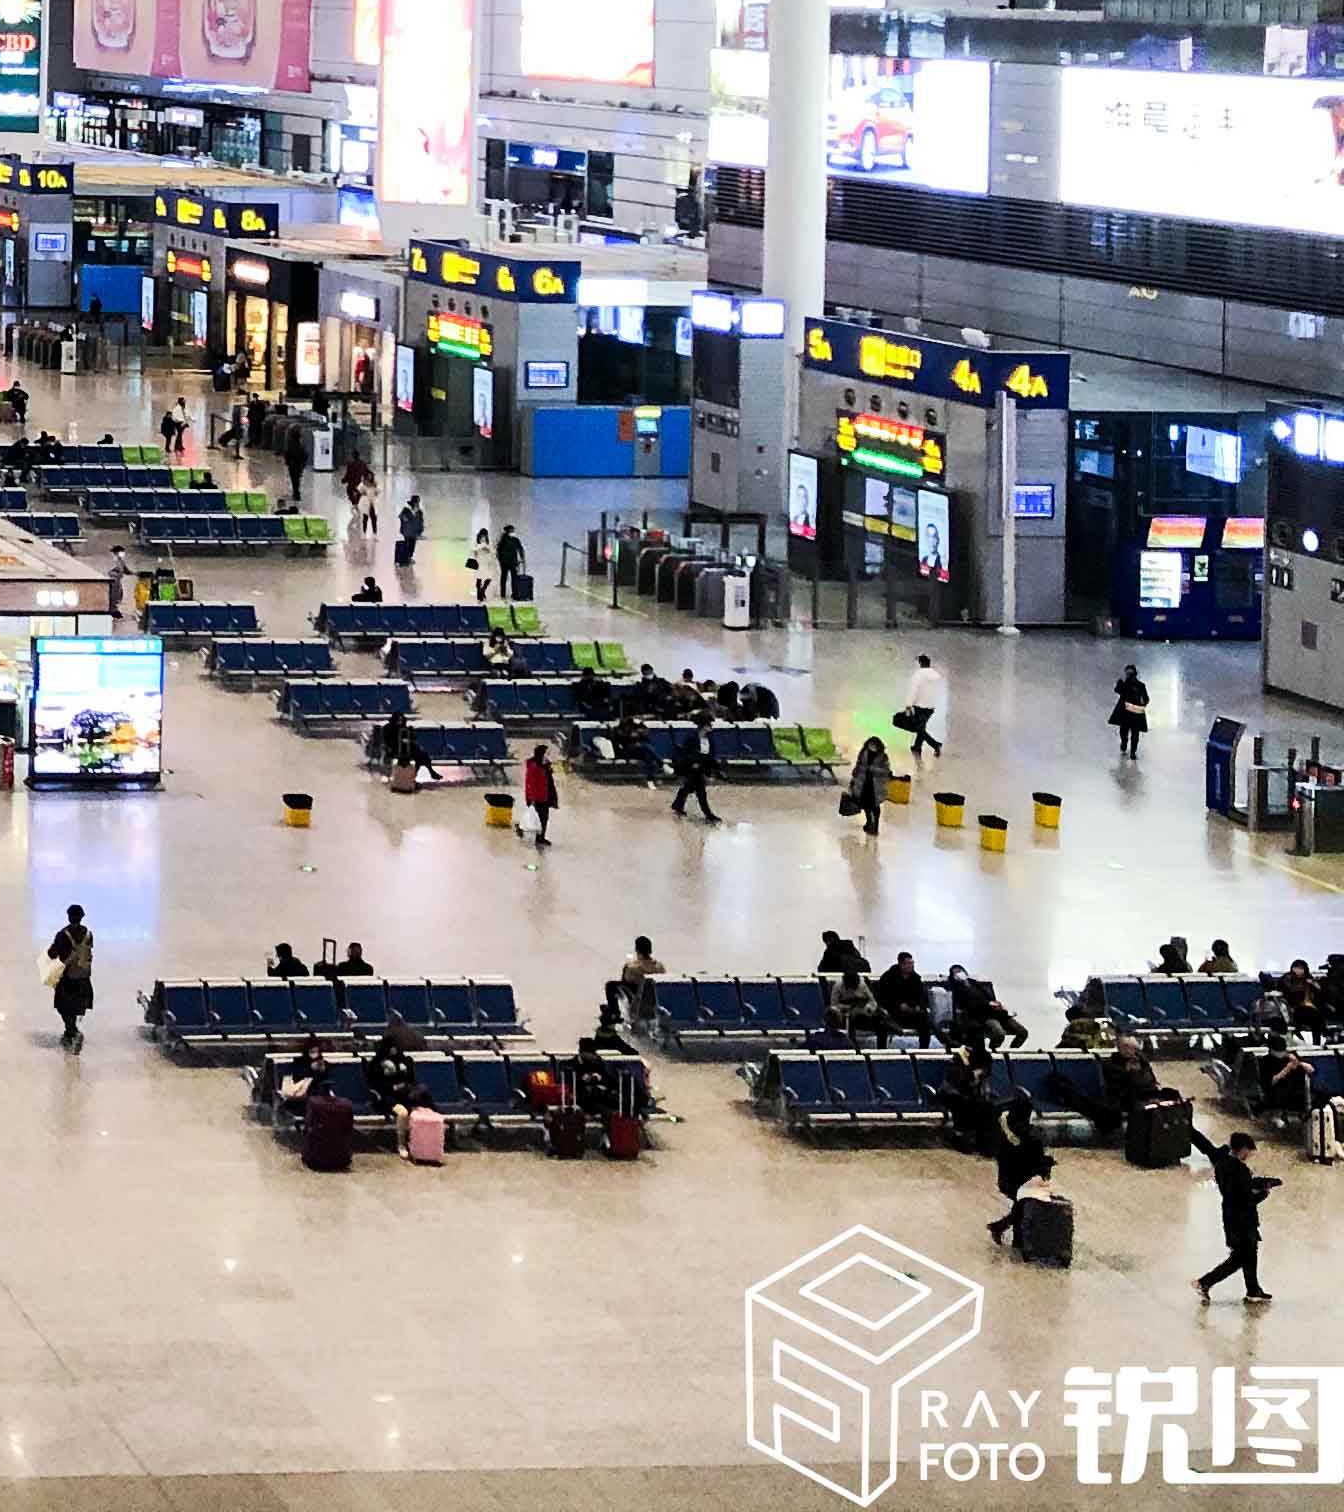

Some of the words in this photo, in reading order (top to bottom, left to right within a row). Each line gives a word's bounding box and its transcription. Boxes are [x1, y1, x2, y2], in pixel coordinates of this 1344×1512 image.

[37, 170, 67, 189] 10A
[240, 209, 267, 231] 8A
[533, 267, 565, 295] 6A
[952, 359, 981, 393] 4A
[1006, 364, 1049, 398] 4A
